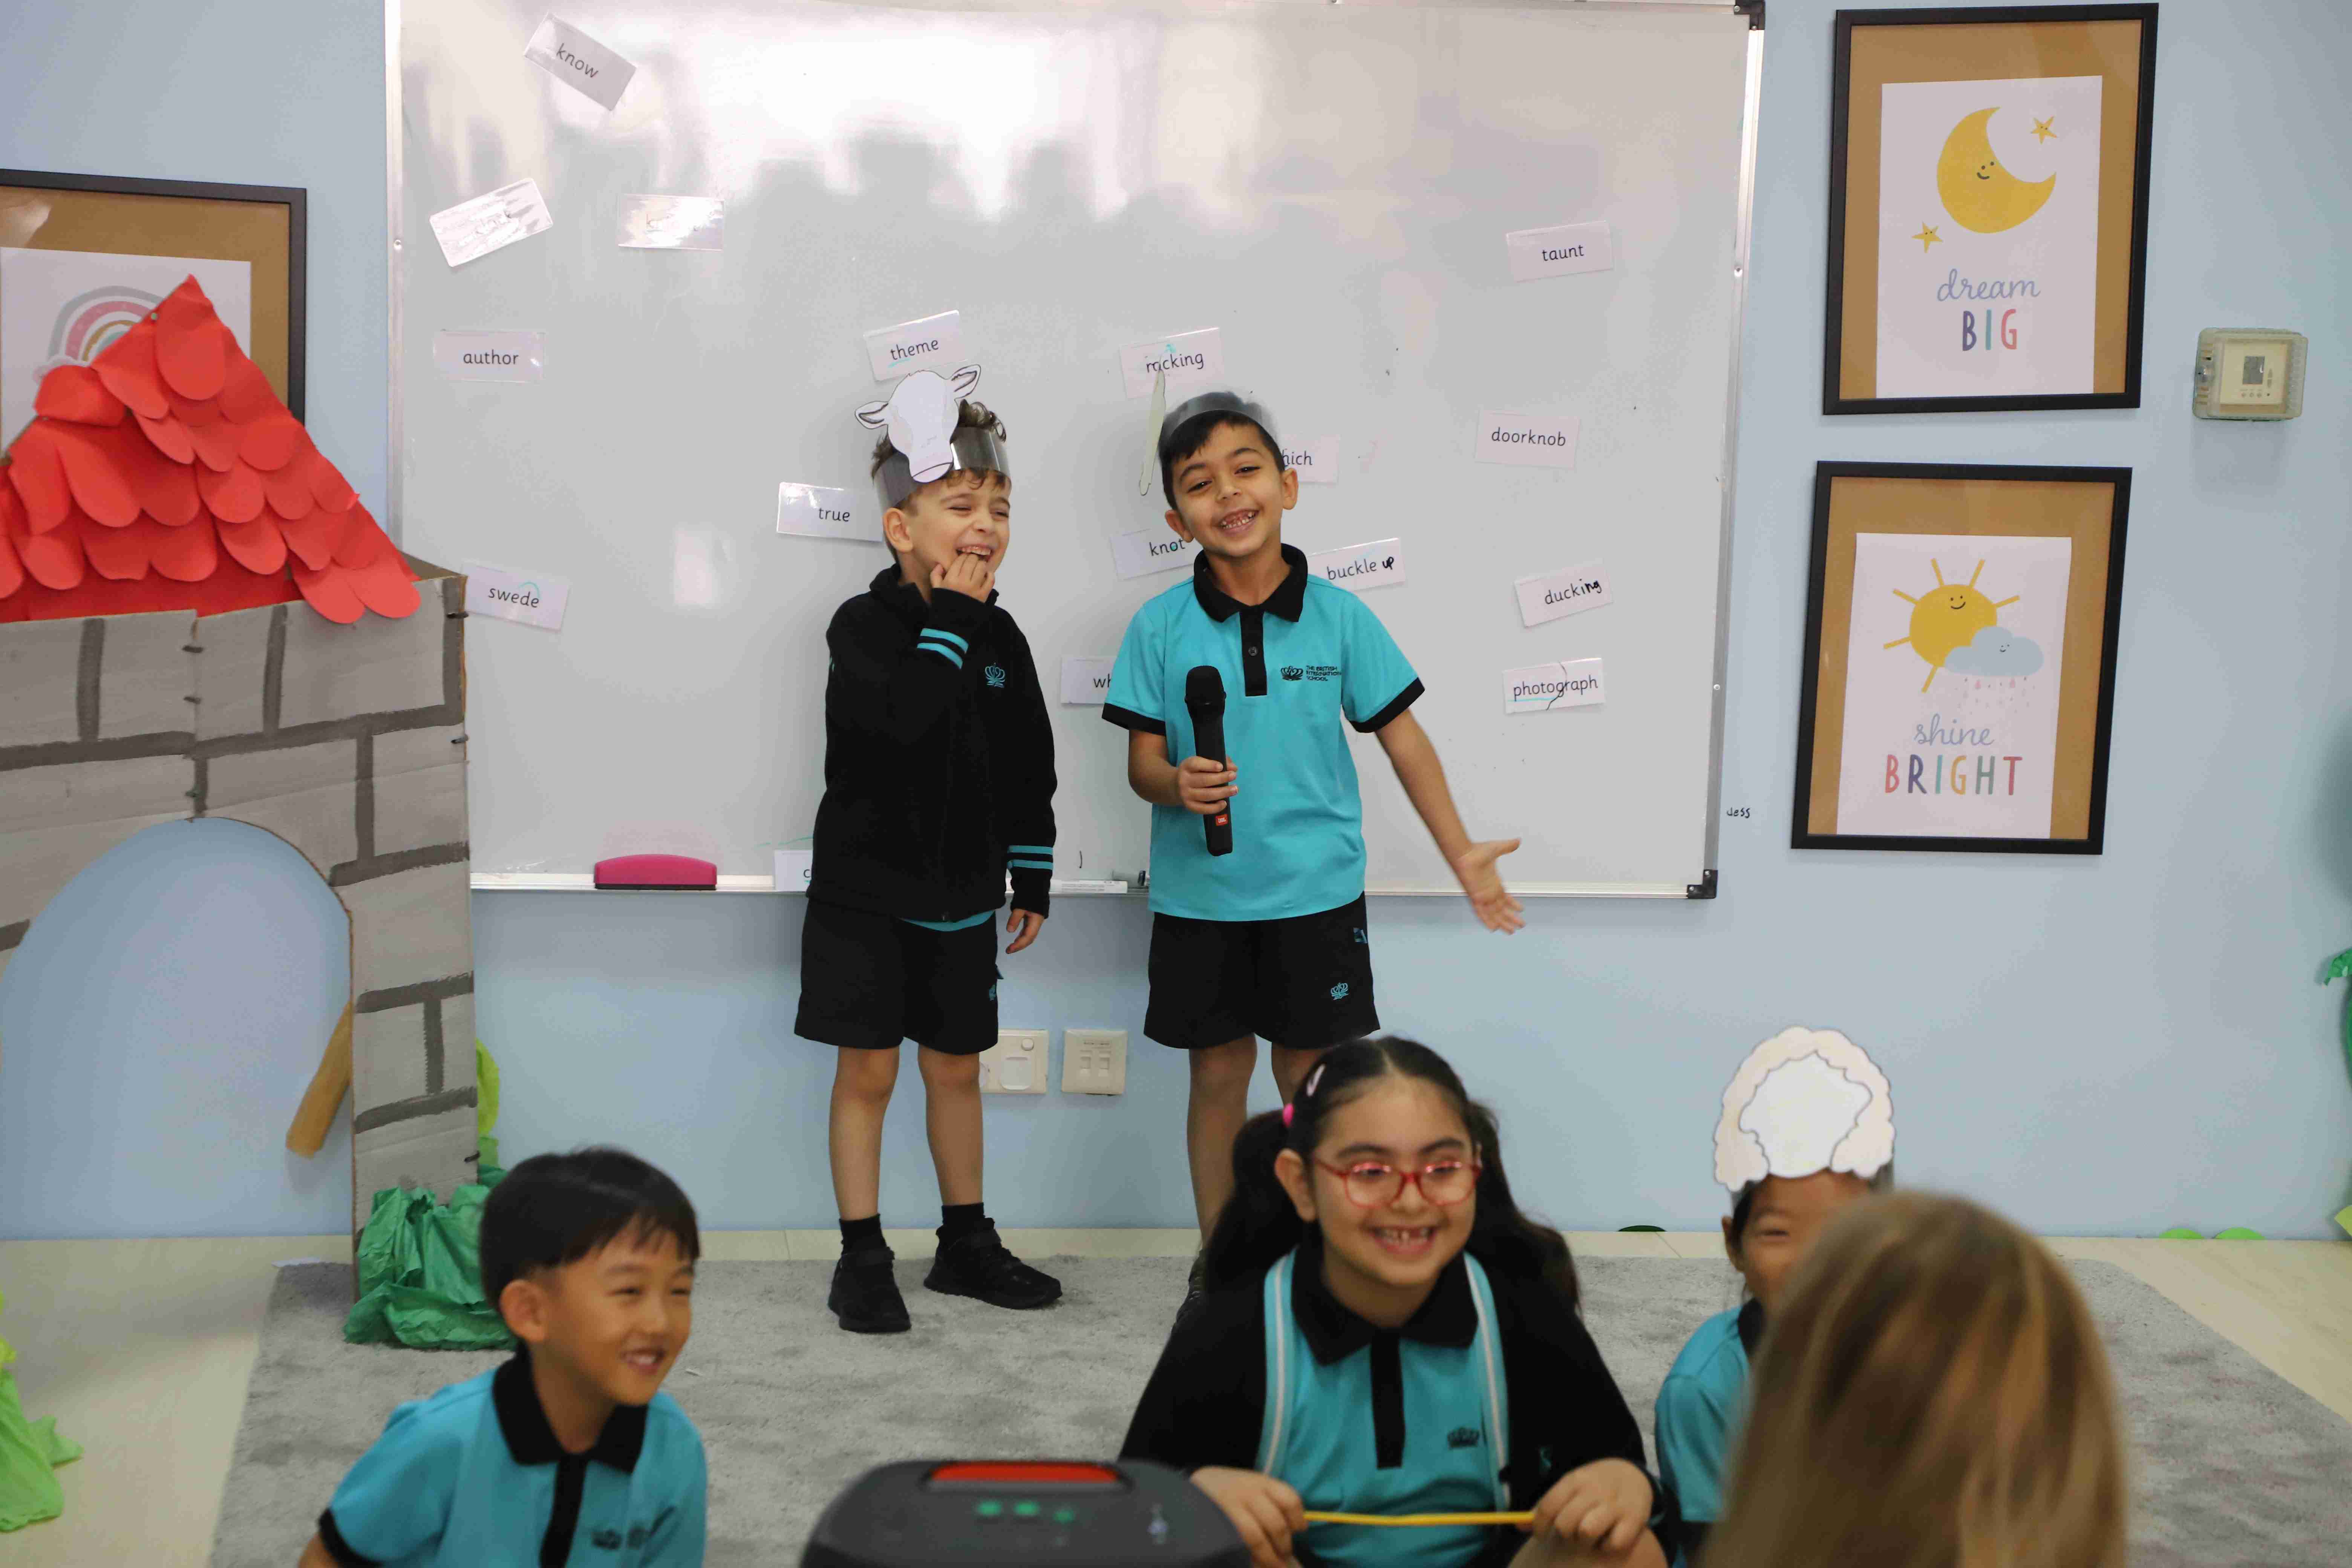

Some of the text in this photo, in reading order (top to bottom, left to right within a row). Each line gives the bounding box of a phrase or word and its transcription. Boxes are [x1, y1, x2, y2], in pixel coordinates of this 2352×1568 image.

[556, 43, 599, 78] know
[1542, 245, 1584, 261] taunt
[1937, 269, 2041, 302] dream
[1962, 309, 2017, 351] BIG
[463, 349, 519, 365] author
[890, 340, 939, 361] theme
[1491, 427, 1566, 446] doorknob
[1282, 450, 1312, 466] hich
[819, 508, 850, 522] true
[1149, 539, 1185, 556] knot
[1327, 559, 1377, 580] buckle
[488, 586, 539, 608] swede
[1545, 579, 1602, 605] ducking
[1514, 675, 1598, 702] photograph
[1914, 714, 1995, 746] shine
[1885, 754, 2023, 796] BRIGHT
